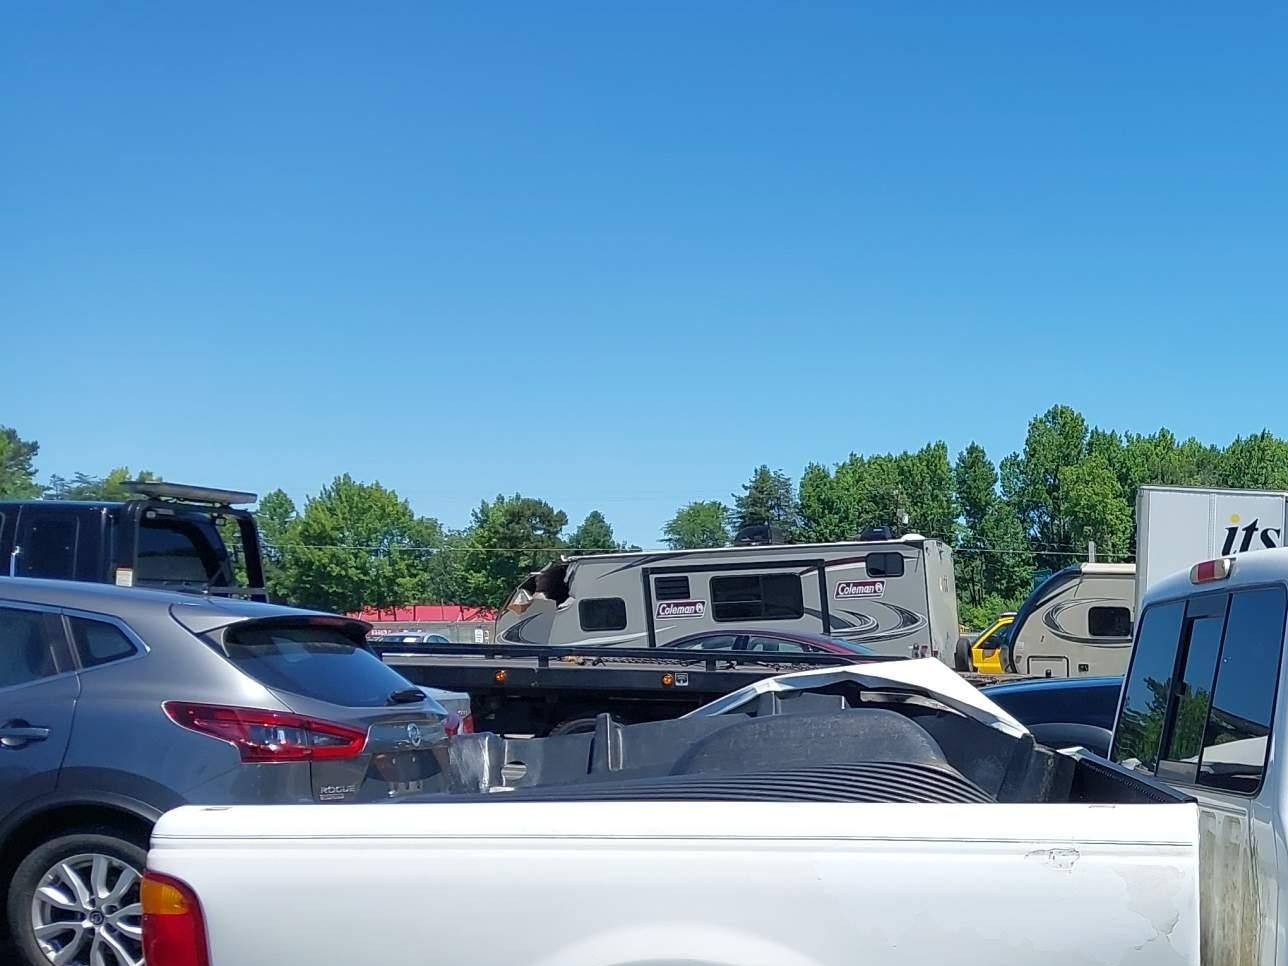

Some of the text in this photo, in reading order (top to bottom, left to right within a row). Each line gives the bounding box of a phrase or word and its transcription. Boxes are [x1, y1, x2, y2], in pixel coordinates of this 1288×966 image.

[1222, 513, 1281, 556] its
[838, 582, 875, 596] Coleman
[659, 603, 695, 616] Coleman
[320, 785, 356, 794] ROGUE
